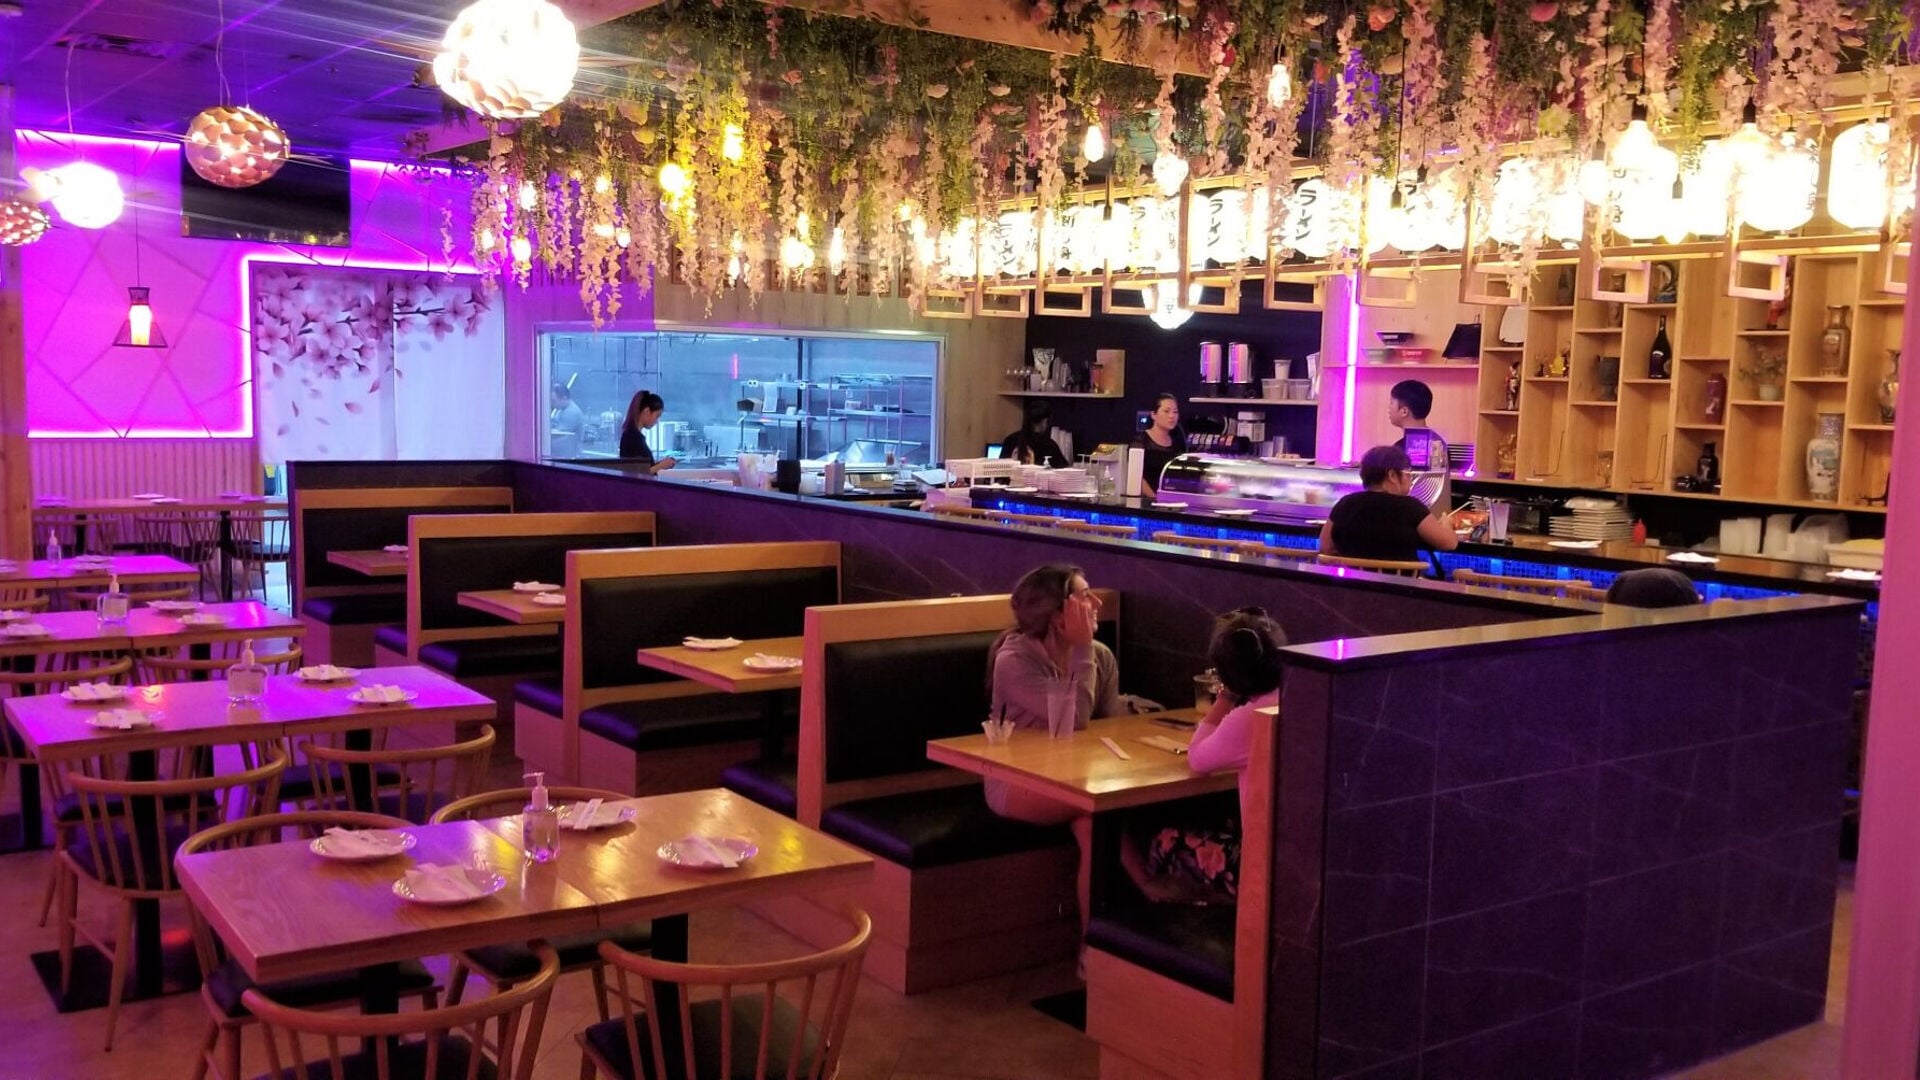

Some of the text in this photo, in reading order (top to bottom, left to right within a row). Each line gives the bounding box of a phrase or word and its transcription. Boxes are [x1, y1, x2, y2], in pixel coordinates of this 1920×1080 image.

[1207, 198, 1223, 248] ラーメン
[1296, 188, 1317, 241] ラーメン
